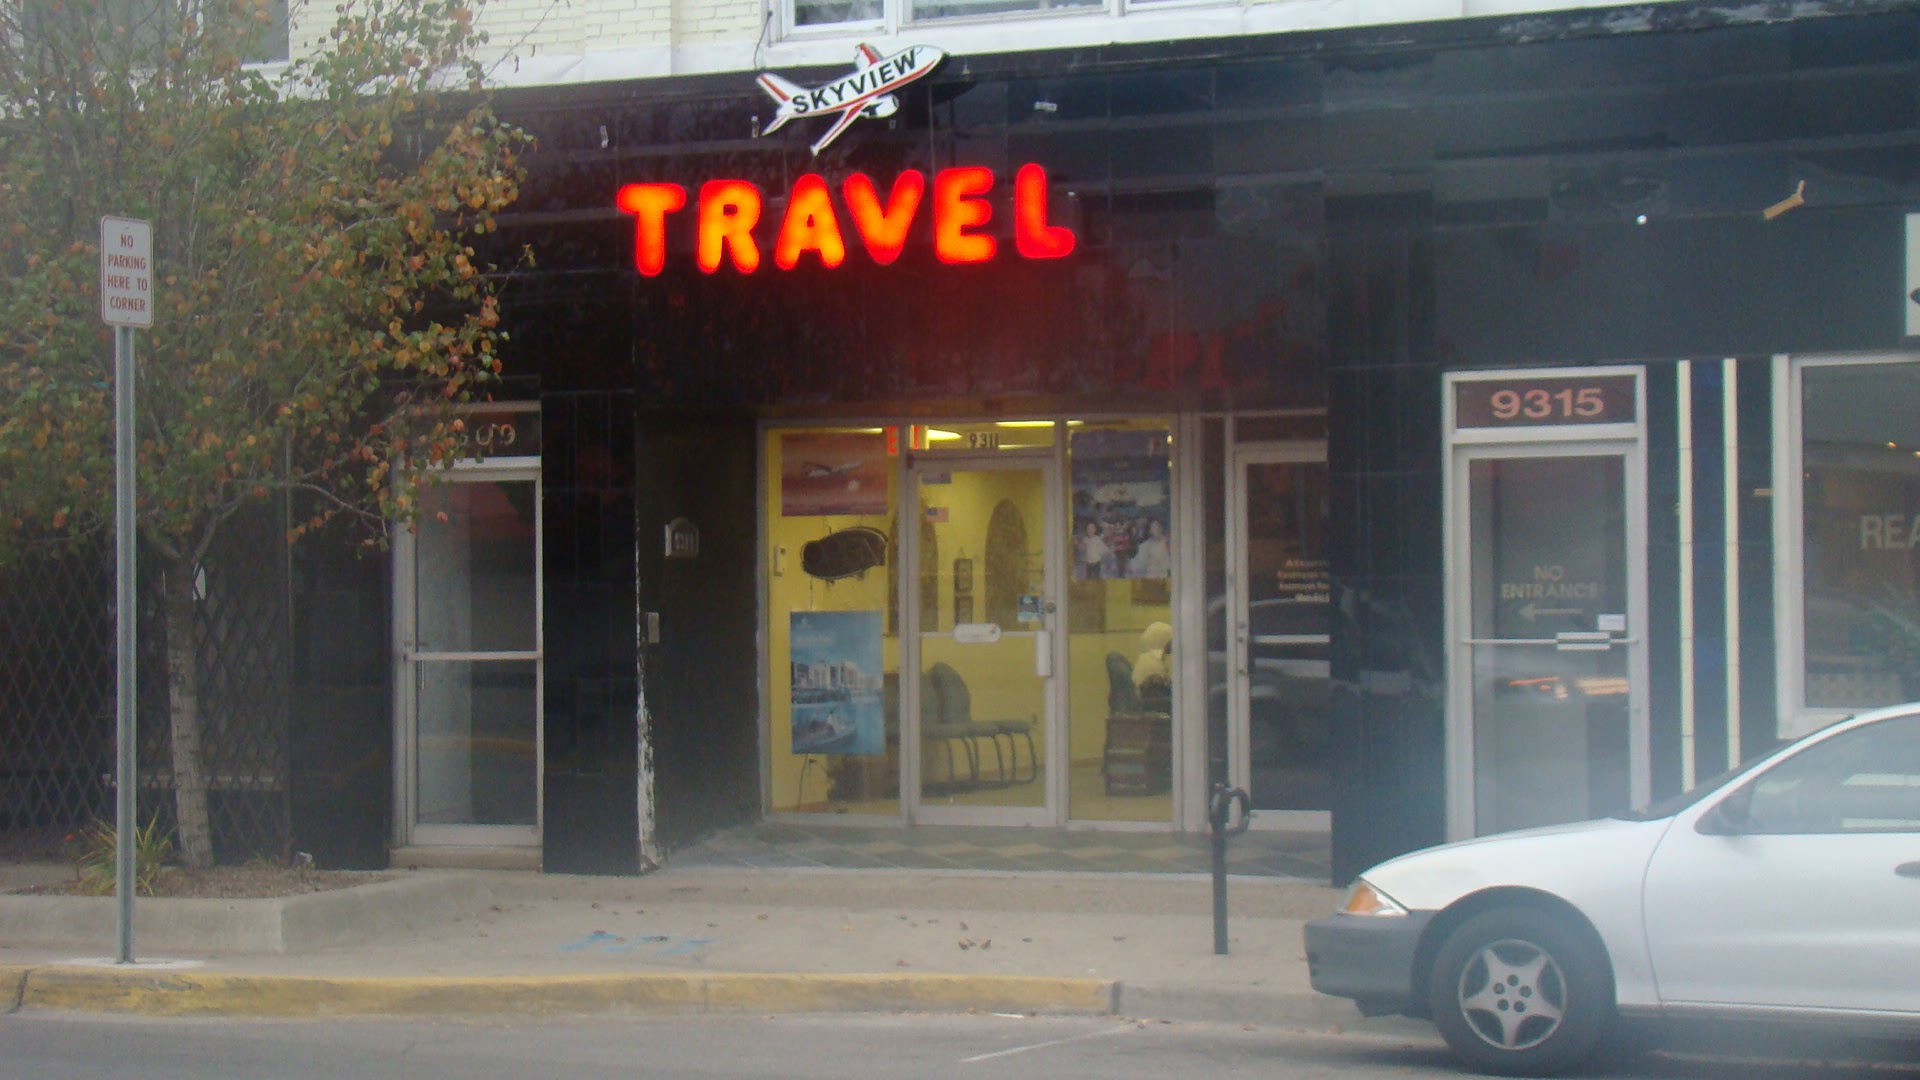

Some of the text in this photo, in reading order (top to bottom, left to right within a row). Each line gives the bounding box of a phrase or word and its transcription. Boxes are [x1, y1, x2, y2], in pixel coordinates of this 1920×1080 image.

[792, 48, 917, 114] SKYVIEW
[617, 162, 1076, 277] TRAVEL
[120, 233, 134, 248] NO
[108, 254, 147, 271] PARKING
[107, 274, 148, 291] HERE TO
[109, 296, 146, 311] CORNER
[1490, 387, 1605, 419] 9315
[968, 431, 1000, 449] 9311
[1533, 564, 1565, 582] NO
[1501, 581, 1600, 600] ENTRANCE
